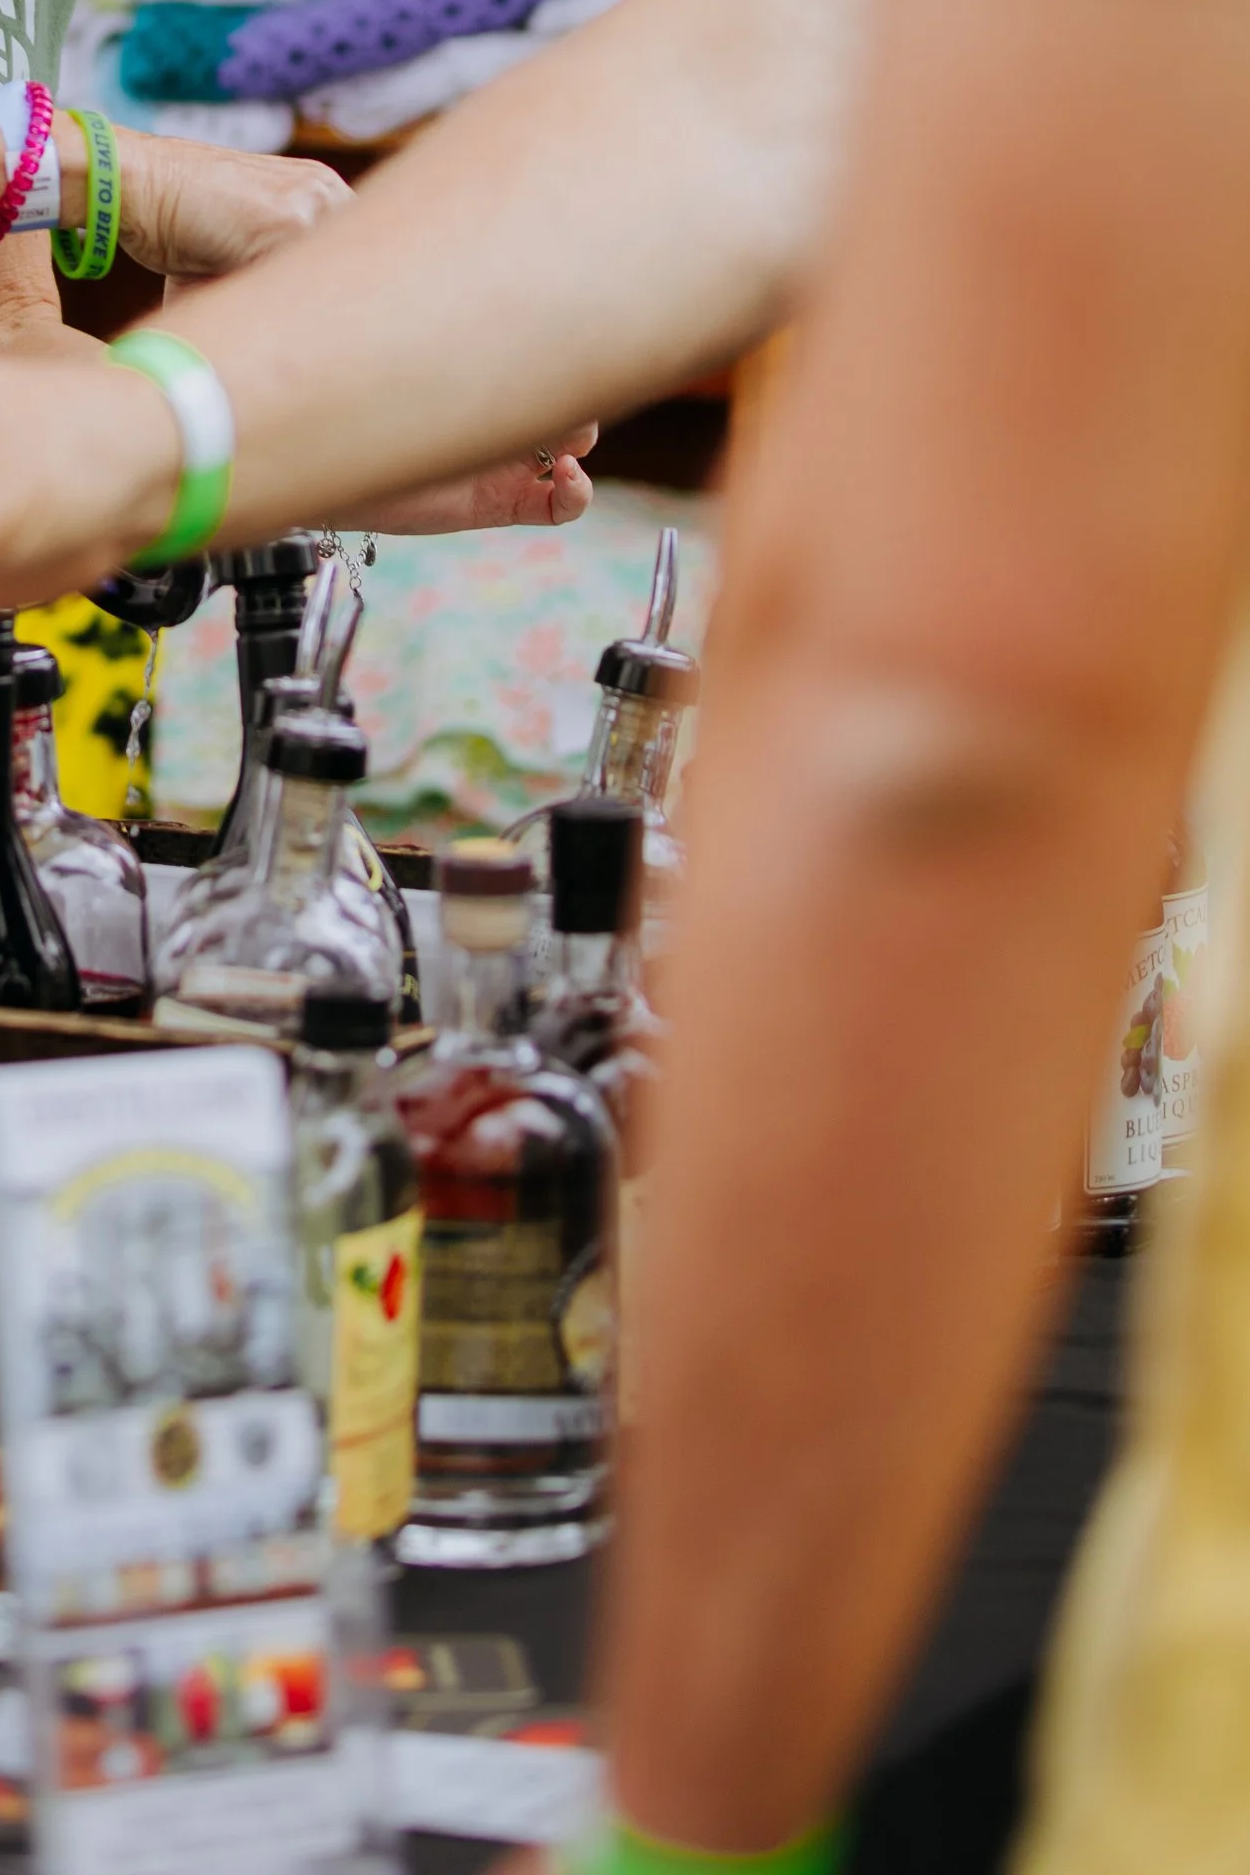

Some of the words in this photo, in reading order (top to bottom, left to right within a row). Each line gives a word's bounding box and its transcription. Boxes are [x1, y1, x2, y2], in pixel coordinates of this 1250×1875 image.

[94, 133, 112, 172] LIVE
[98, 177, 113, 204] TO
[93, 210, 112, 260] BIKE
